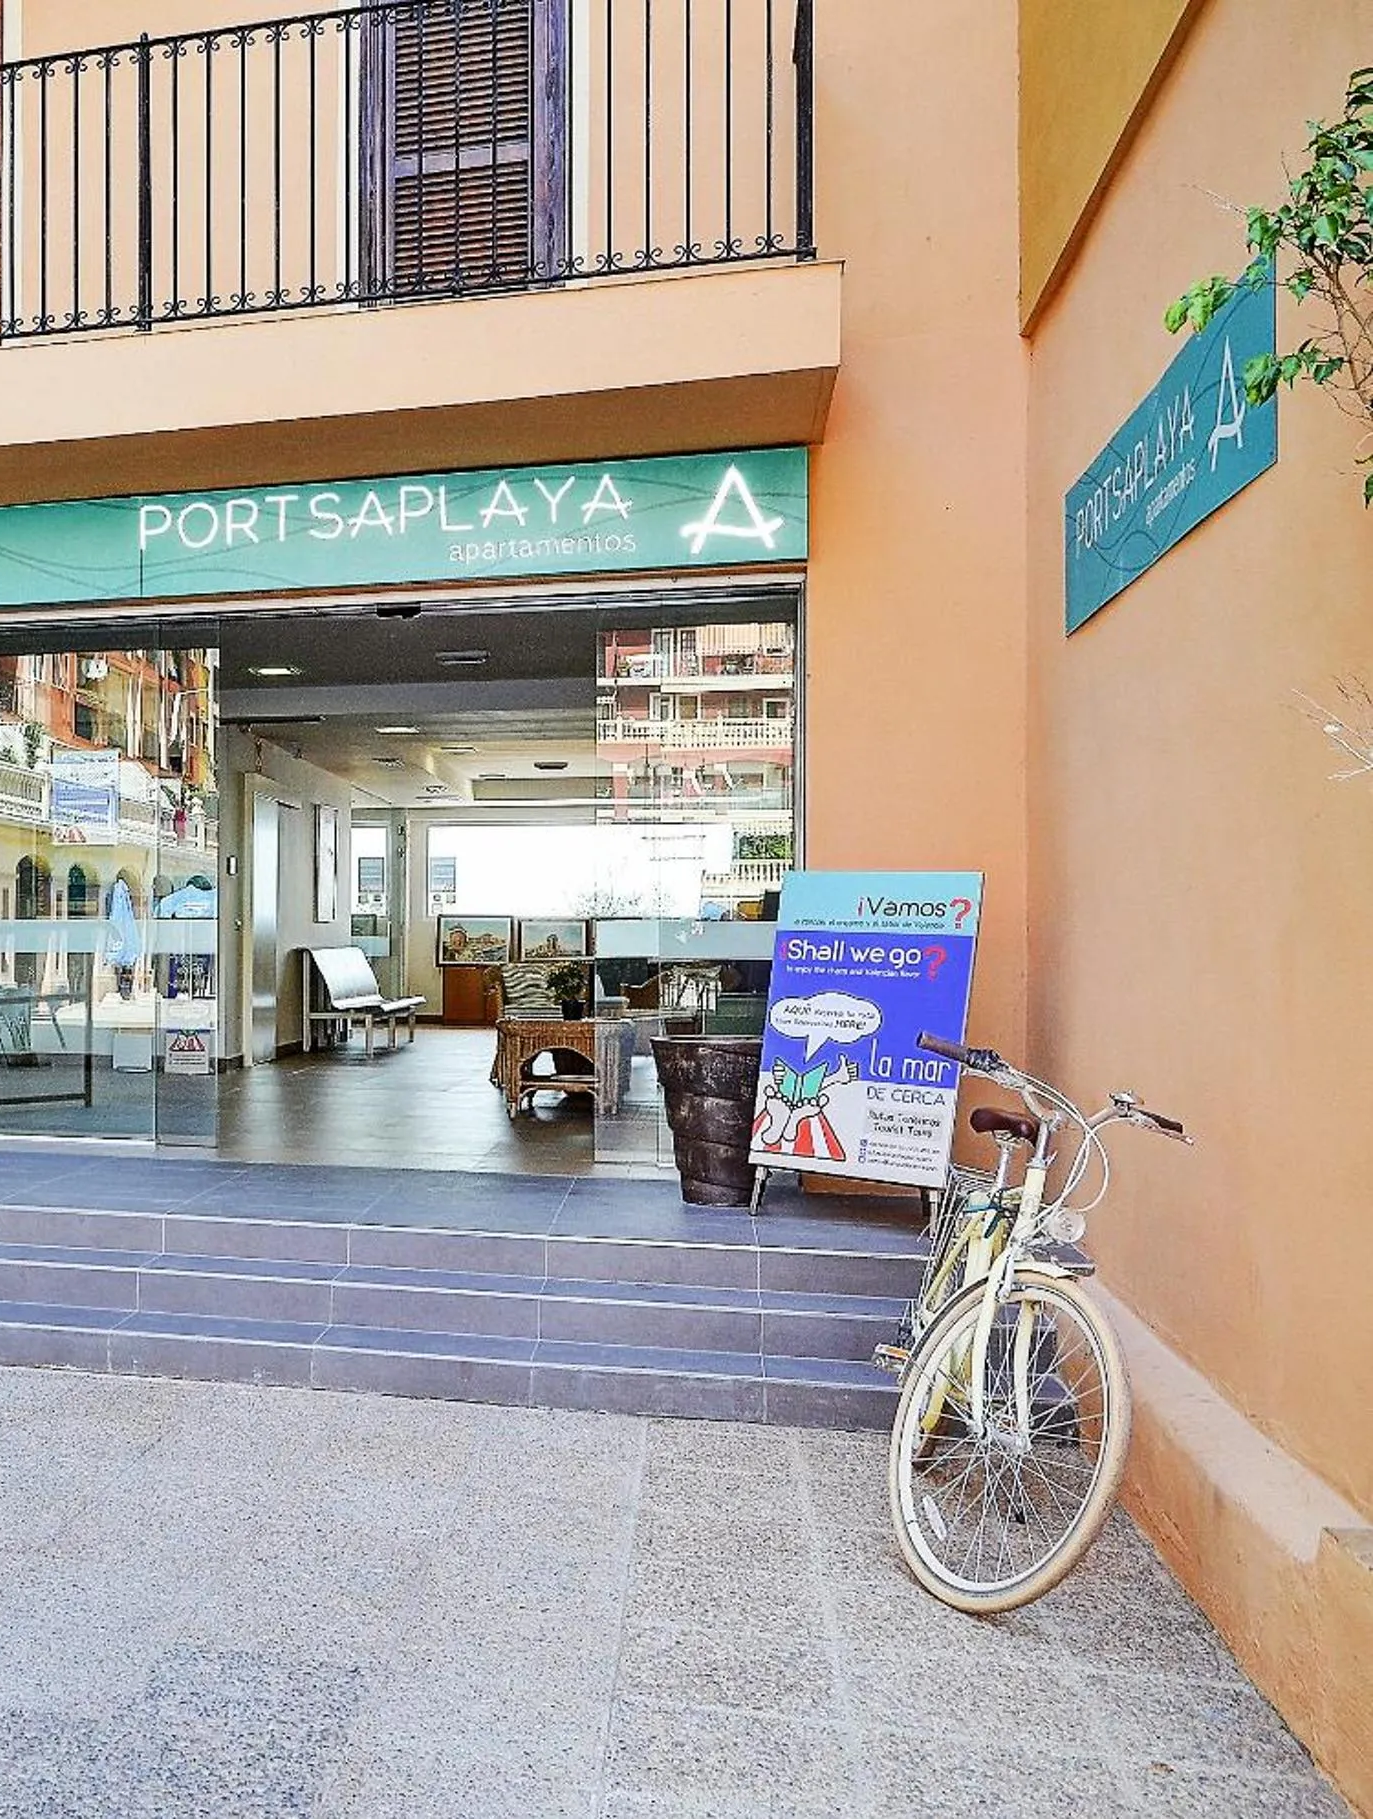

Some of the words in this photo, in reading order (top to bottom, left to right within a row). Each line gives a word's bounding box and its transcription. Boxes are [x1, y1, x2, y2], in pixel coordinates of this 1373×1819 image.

[1076, 384, 1195, 558] PORTSAPLAYA
[138, 473, 633, 552] PORTSAPLAYA
[448, 533, 637, 564] apartamentos
[850, 948, 884, 964] we
[869, 1037, 892, 1078] la
[901, 1058, 952, 1083] mar
[866, 1085, 887, 1102] DE
[890, 1087, 946, 1106] CERCA
